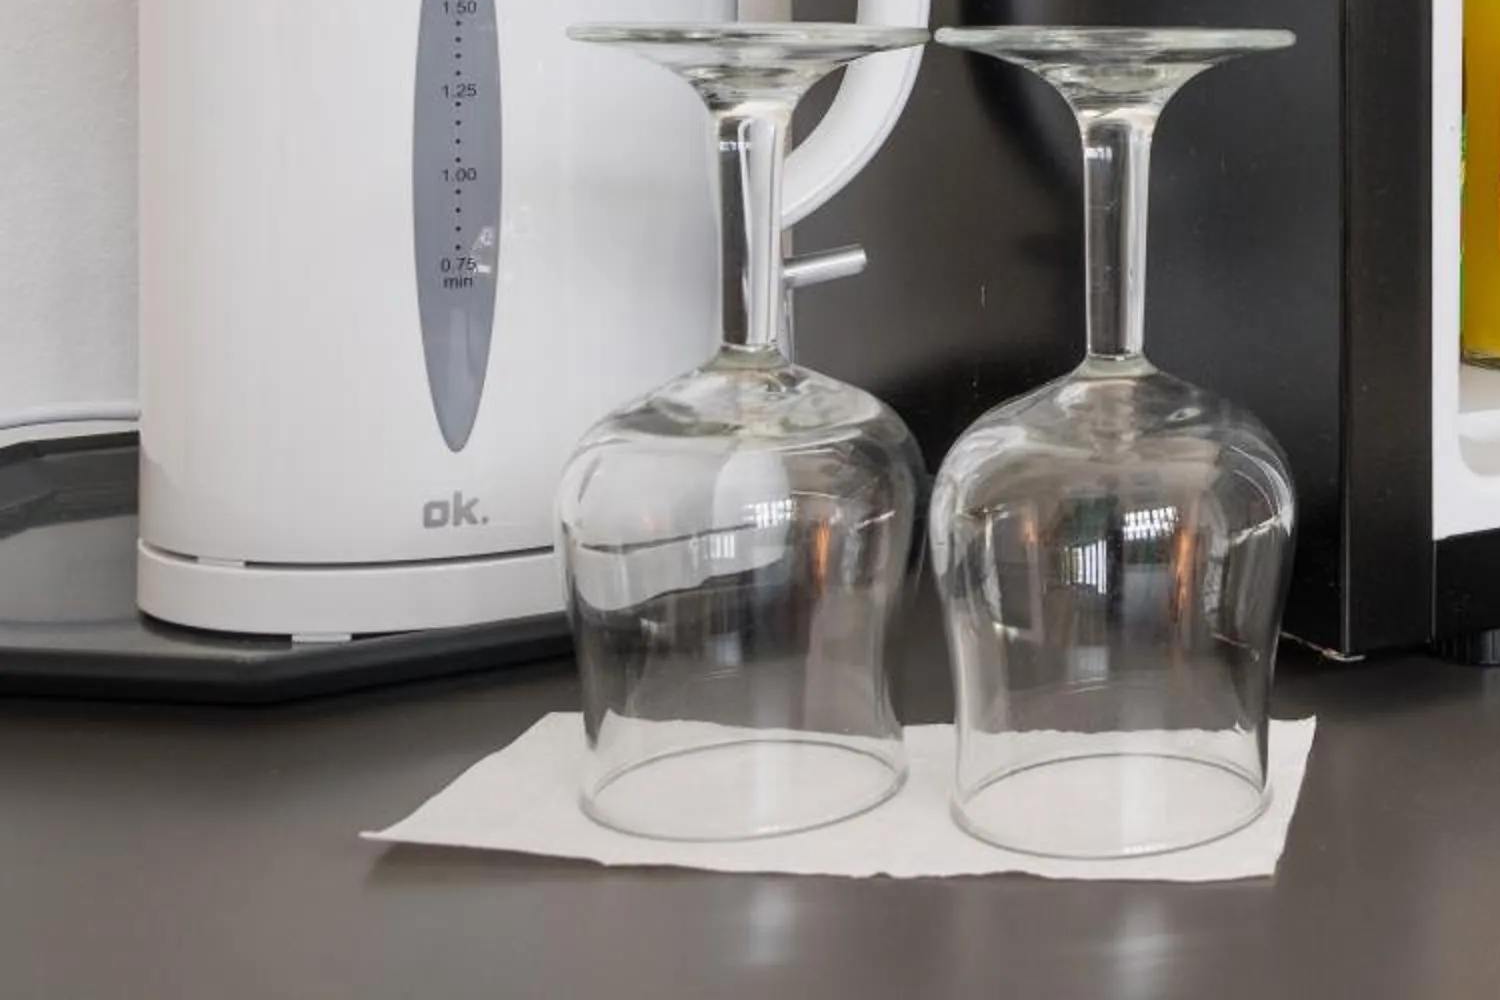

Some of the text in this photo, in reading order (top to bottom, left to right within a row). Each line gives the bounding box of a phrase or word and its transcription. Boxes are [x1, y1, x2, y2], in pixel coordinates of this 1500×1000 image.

[442, 0, 477, 15] 1.50
[442, 83, 477, 98] 1.25
[442, 167, 477, 182] 1.00
[441, 257, 477, 273] 0.75
[443, 276, 473, 289] min
[423, 490, 489, 529] ok.
